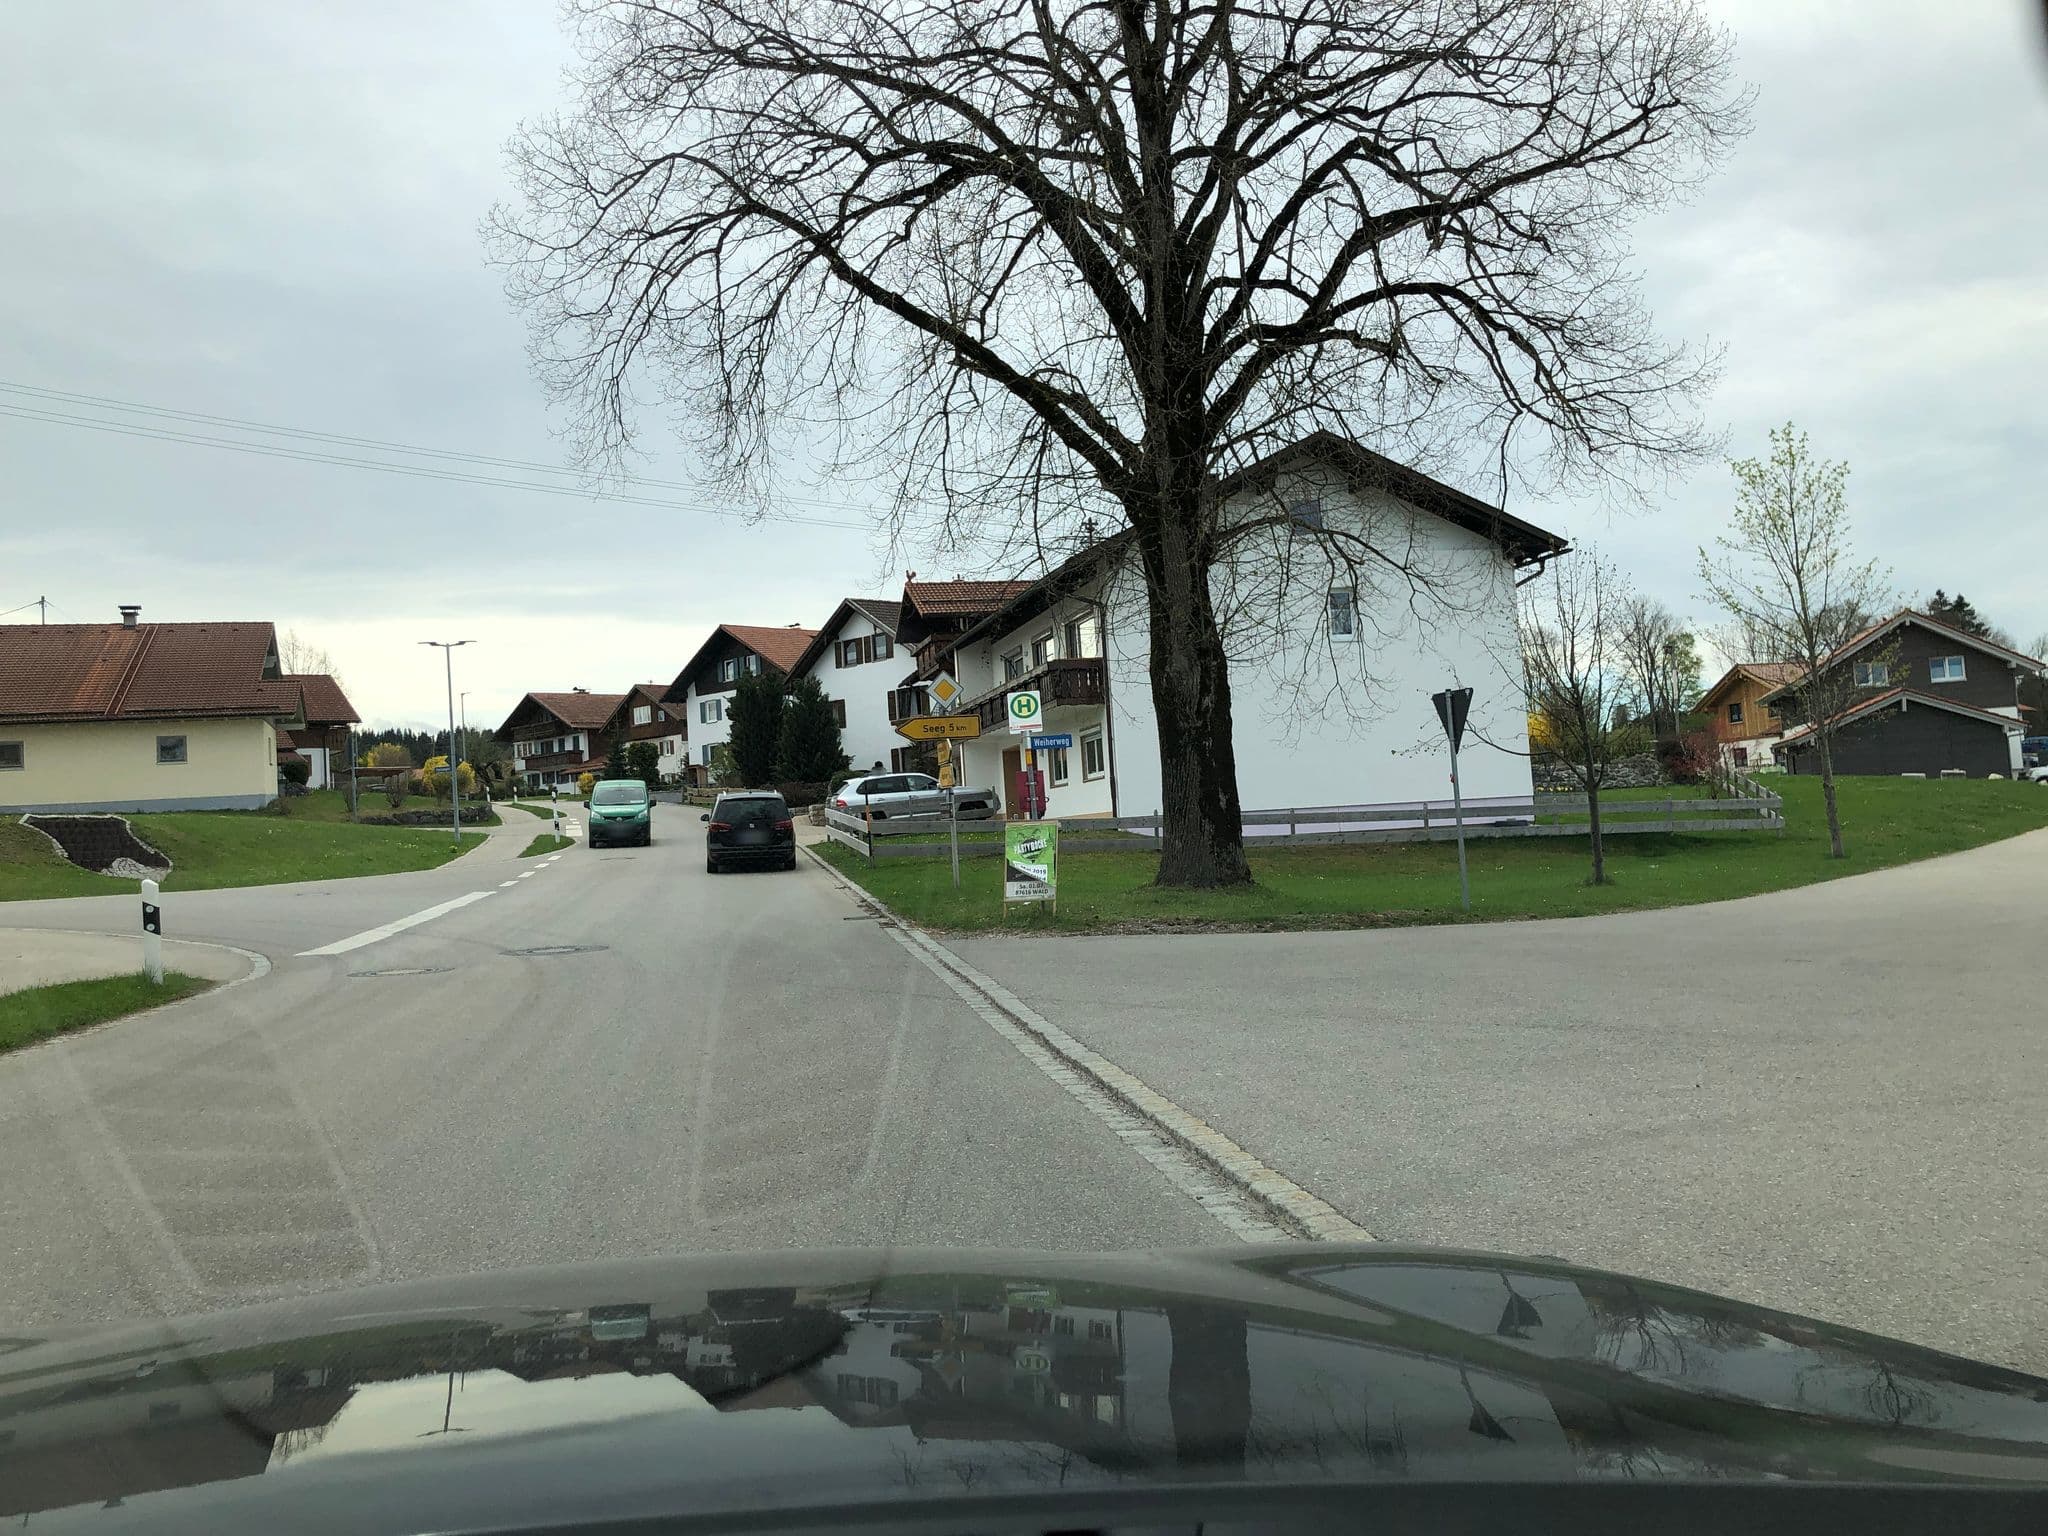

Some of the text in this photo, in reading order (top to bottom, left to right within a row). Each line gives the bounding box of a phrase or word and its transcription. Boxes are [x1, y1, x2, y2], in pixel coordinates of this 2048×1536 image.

[1017, 698, 1032, 713] H
[923, 724, 946, 734] Seeg
[949, 723, 955, 732] 5
[1033, 736, 1070, 748] Weiherweg
